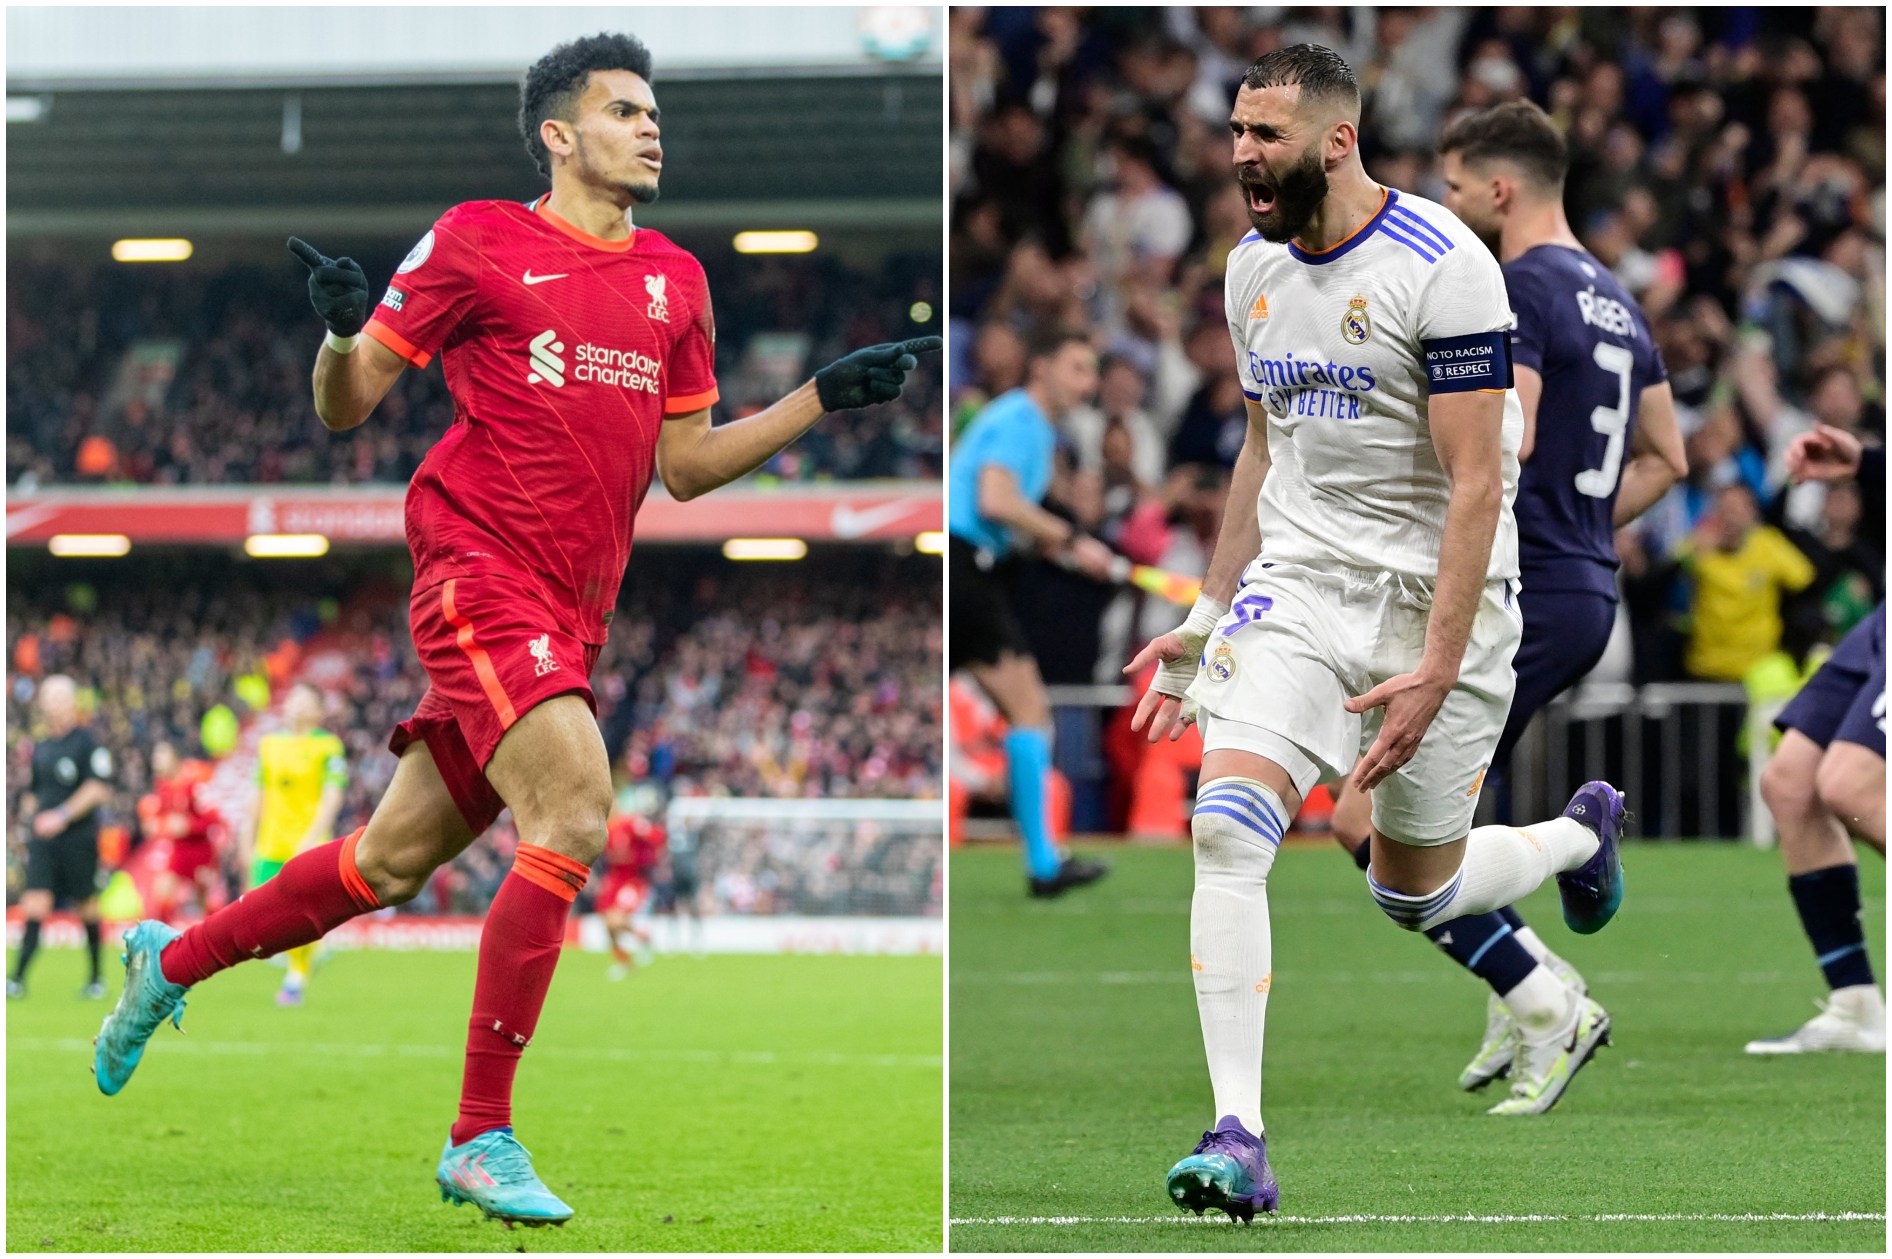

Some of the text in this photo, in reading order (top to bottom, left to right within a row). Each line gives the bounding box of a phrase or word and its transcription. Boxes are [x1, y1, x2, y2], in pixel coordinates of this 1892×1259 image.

[575, 342, 661, 379] standard
[1426, 345, 1493, 361] NO TO RACISM
[1445, 363, 1491, 377] RESPECT
[1249, 351, 1376, 392] Emirates
[1298, 388, 1360, 420] BETTER
[1575, 342, 1634, 499] 3
